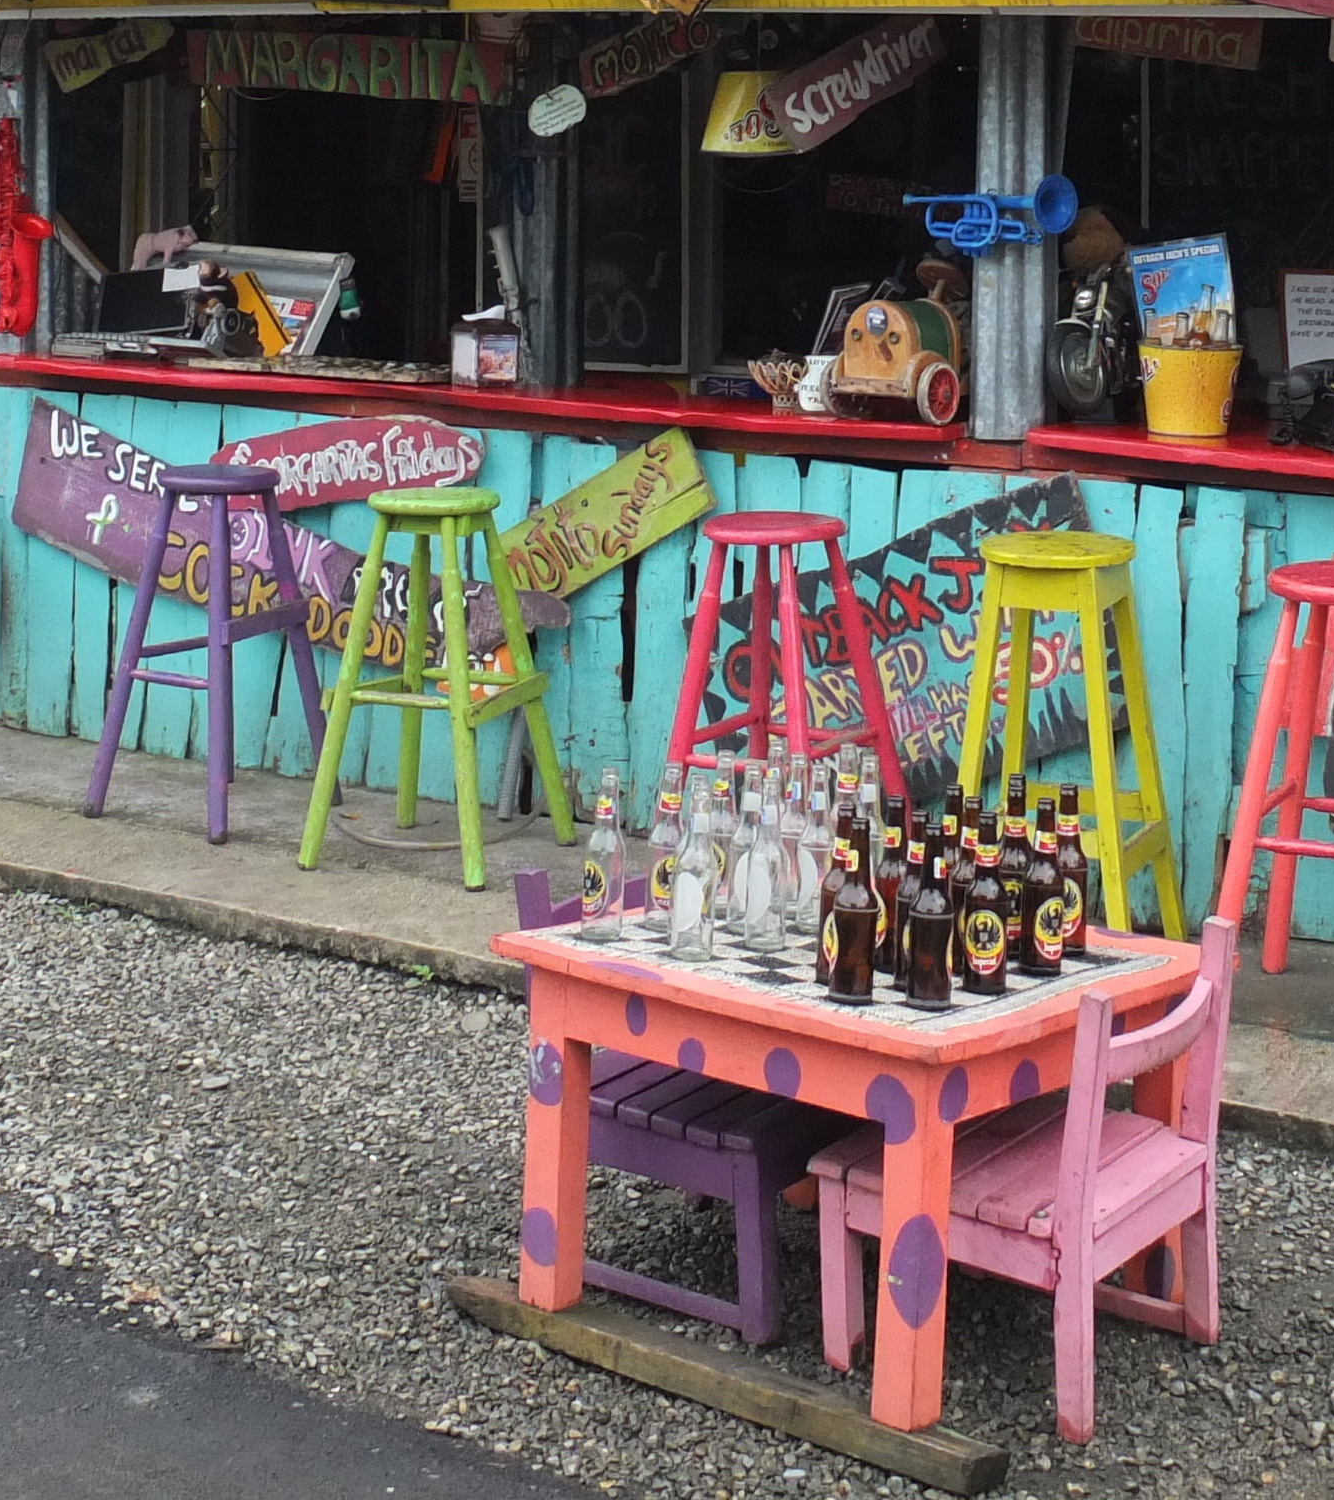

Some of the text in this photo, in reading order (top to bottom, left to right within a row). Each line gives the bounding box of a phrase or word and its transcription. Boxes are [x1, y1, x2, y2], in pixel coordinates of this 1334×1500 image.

[205, 28, 491, 105] MARGARITA
[49, 409, 105, 461] WE
[306, 595, 438, 669] DOODE
